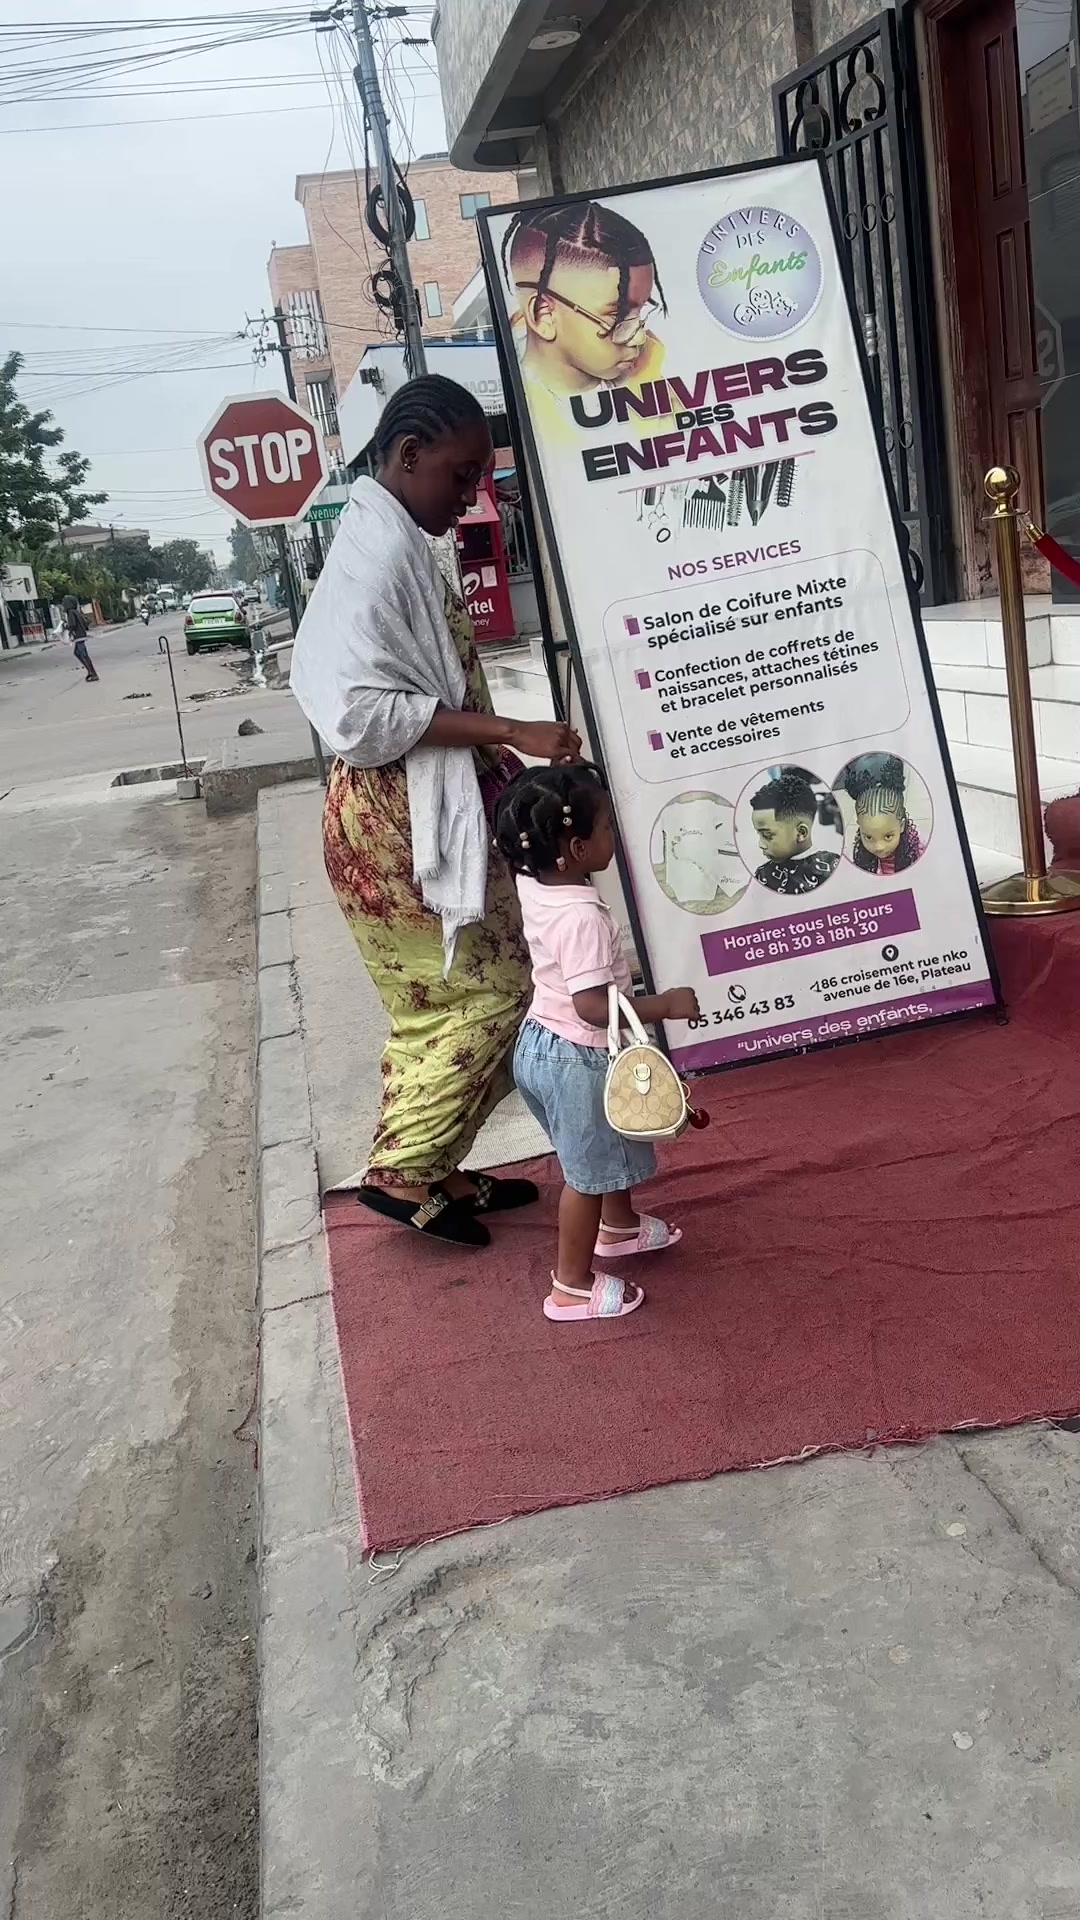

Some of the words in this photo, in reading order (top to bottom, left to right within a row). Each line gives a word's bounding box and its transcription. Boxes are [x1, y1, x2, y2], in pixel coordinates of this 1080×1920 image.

[701, 209, 800, 255] UNIVERS
[707, 250, 809, 290] Enfants
[569, 349, 829, 429] UNIVERS
[675, 402, 735, 430] DES
[209, 428, 312, 490] STOP
[581, 401, 838, 482] ENFANTS
[667, 560, 708, 580] NOS
[712, 540, 802, 571] SERVICES
[643, 608, 694, 631] Salon
[699, 604, 721, 619] de
[726, 587, 792, 612] Coifure
[796, 575, 847, 597] Mixte
[647, 617, 737, 650] spécialisé
[741, 611, 769, 628] sur
[774, 595, 844, 621] enfants
[655, 655, 741, 682] Confection
[745, 650, 765, 663] de
[769, 635, 831, 659] coffrets
[835, 629, 855, 643] de
[657, 670, 748, 698] naissances,
[751, 652, 820, 678] attaches
[823, 639, 879, 662] tétines
[661, 701, 677, 713] et
[681, 684, 746, 710] bracelet
[750, 659, 859, 696] personnalisés
[666, 722, 713, 744] Vente
[717, 719, 737, 733] de
[740, 698, 825, 728] vêtements
[670, 747, 687, 759] et
[690, 726, 780, 755] accessoires
[723, 927, 786, 950] Horaire:
[789, 916, 825, 935] tous
[827, 912, 850, 927] les
[852, 902, 893, 923] jours
[744, 947, 764, 961] de
[768, 941, 789, 957] 8h
[793, 936, 812, 951] 30
[816, 933, 826, 946] à
[828, 926, 856, 942] 18h
[859, 920, 879, 936] 30
[823, 982, 871, 1002] avenue
[874, 979, 891, 991] de
[893, 972, 919, 987] 16e,
[921, 961, 971, 981] Plateau
[840, 961, 915, 987] croisement
[917, 955, 940, 968] rue
[942, 949, 969, 963] nko
[712, 1006, 745, 1025] 346
[749, 1000, 770, 1016] 43
[774, 995, 796, 1011] 83
[817, 1015, 852, 1036] des
[856, 1000, 933, 1027] enfants,
